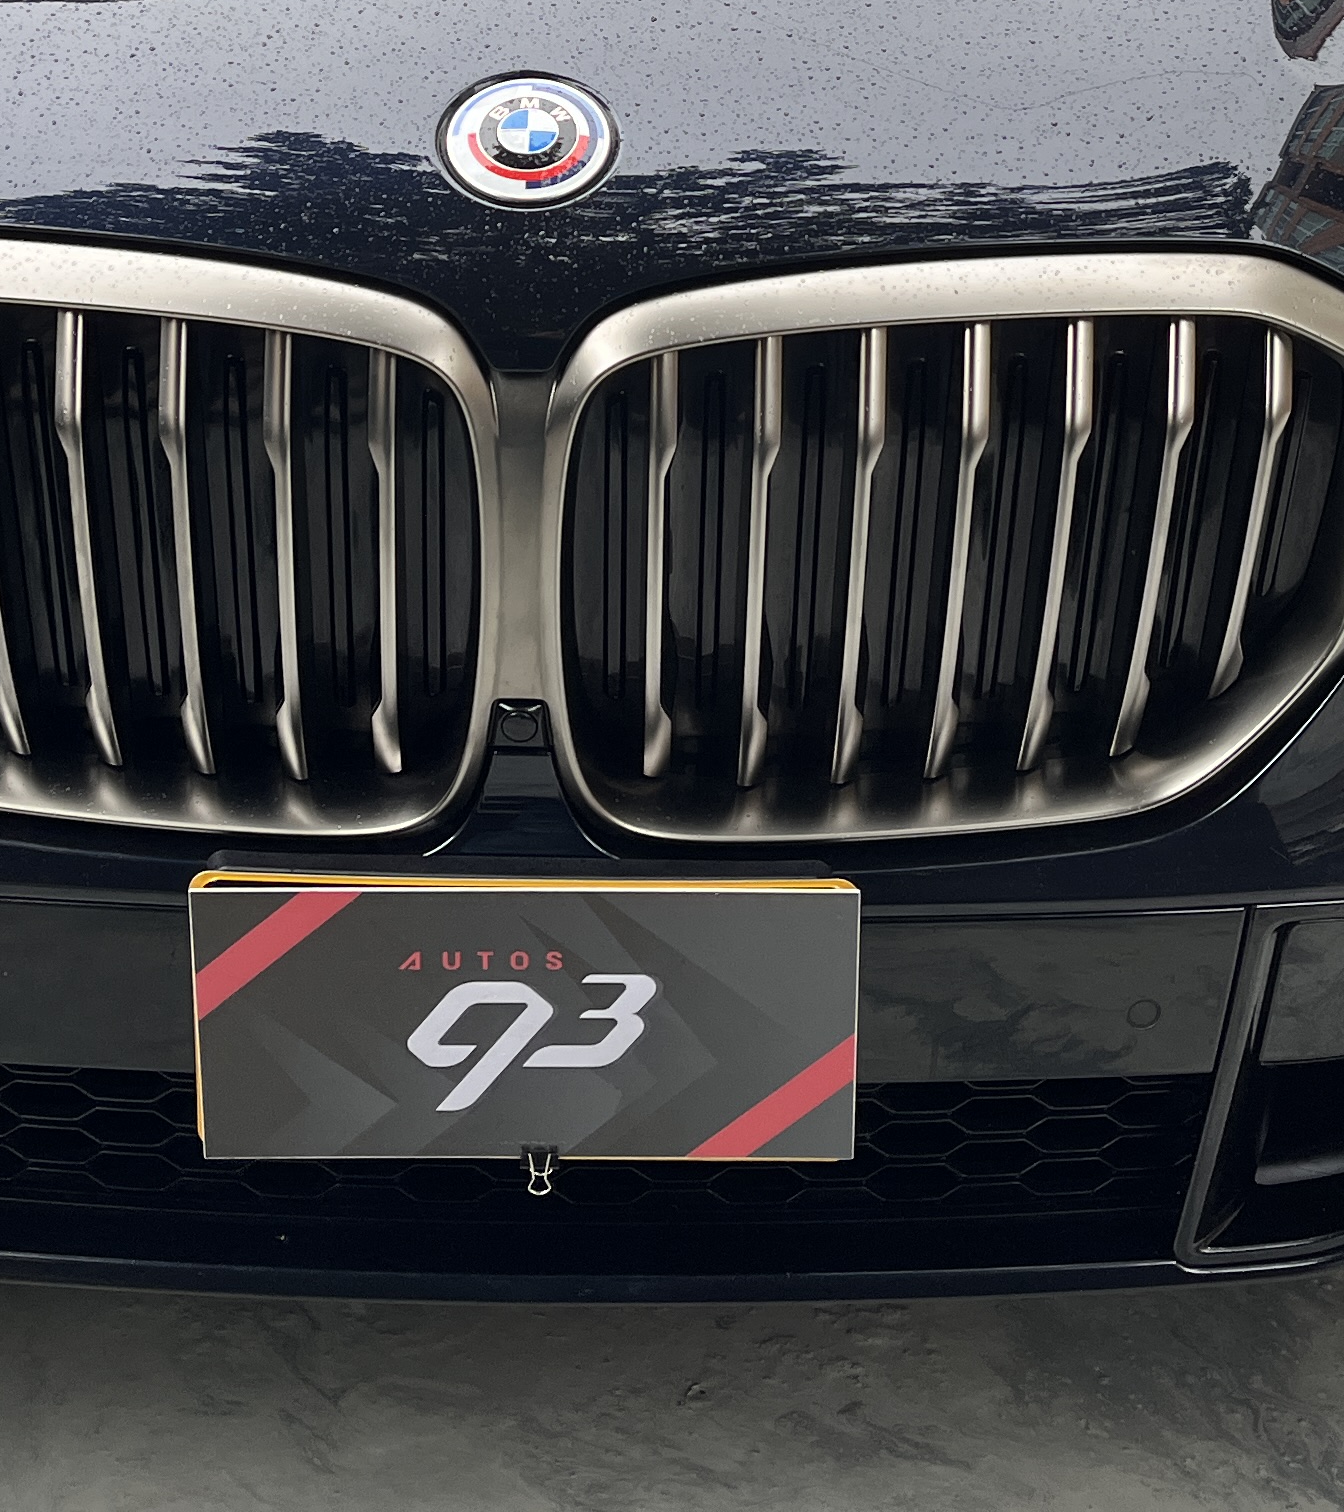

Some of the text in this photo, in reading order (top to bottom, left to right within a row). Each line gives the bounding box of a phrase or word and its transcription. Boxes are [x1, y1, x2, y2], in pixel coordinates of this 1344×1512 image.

[488, 97, 572, 122] BMW
[398, 951, 564, 971] AUTOS
[407, 974, 657, 1112] 93
